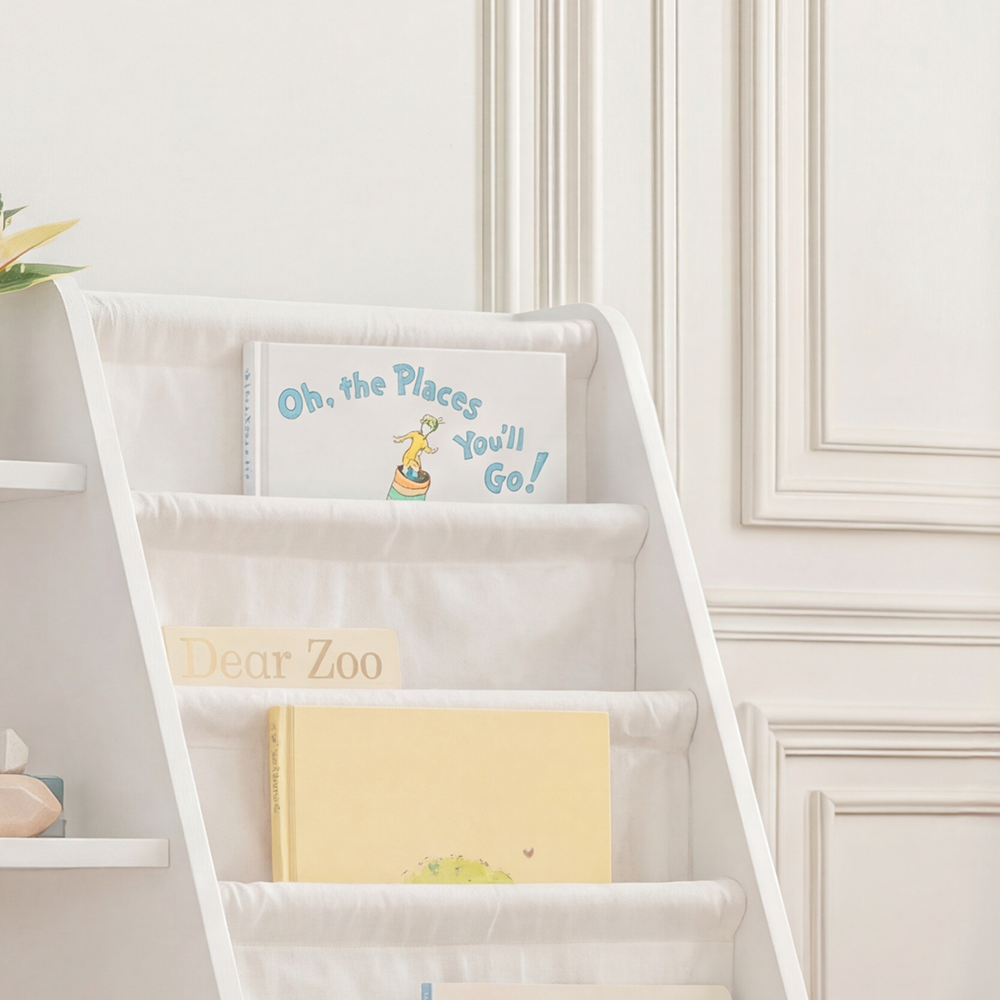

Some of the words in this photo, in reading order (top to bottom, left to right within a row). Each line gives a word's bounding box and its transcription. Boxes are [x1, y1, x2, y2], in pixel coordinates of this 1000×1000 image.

[278, 382, 335, 420] Oh,
[339, 371, 386, 400] the
[392, 363, 483, 420] Places
[452, 424, 524, 460] You'll
[484, 452, 549, 494] Go!
[179, 637, 292, 680] Dear
[307, 638, 382, 680] Zoo
